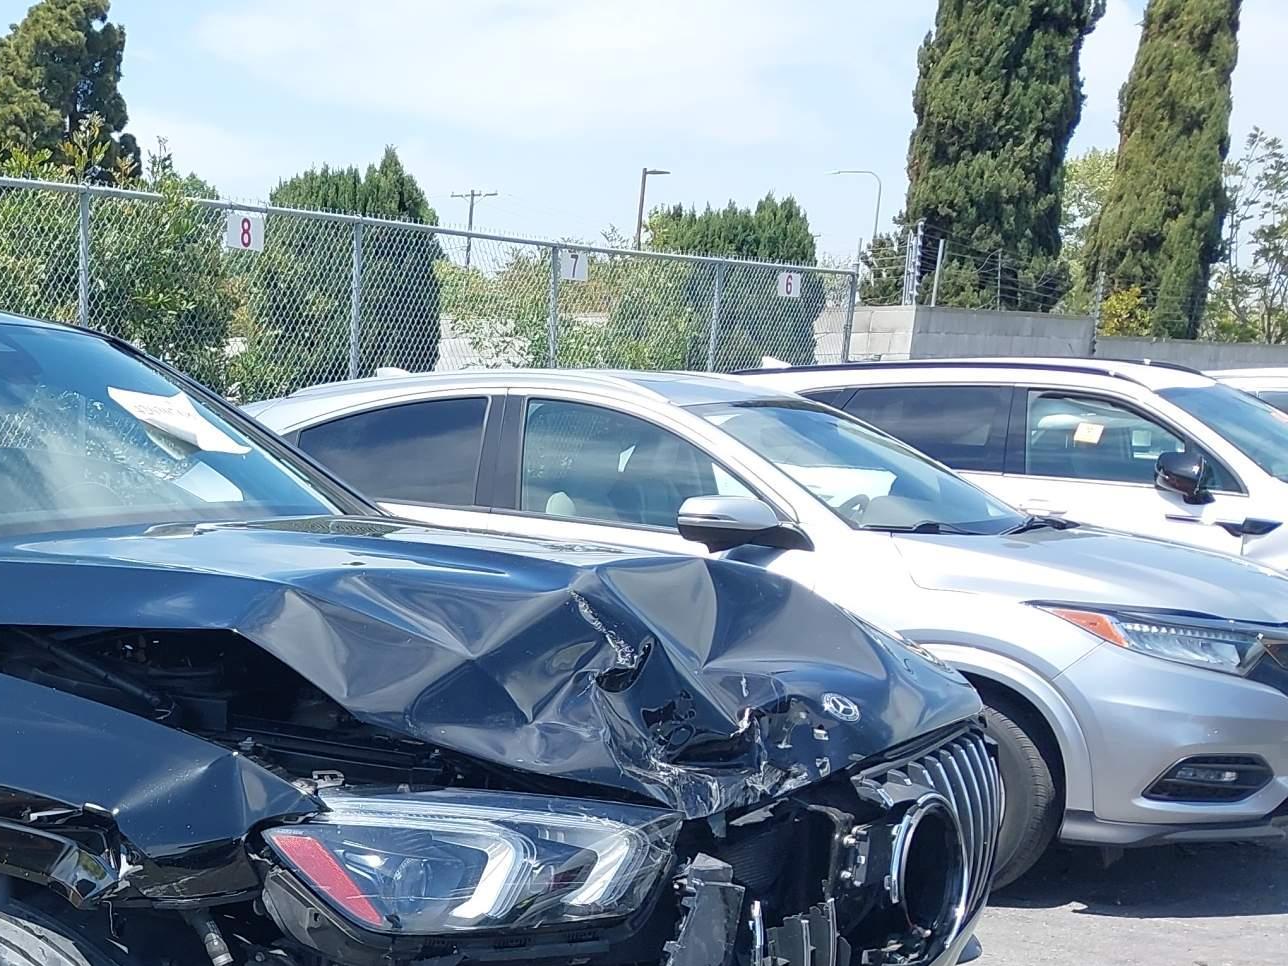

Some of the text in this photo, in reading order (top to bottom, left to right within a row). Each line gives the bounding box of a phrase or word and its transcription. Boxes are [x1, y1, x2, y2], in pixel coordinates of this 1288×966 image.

[241, 217, 251, 248] 8
[570, 254, 579, 278] 7
[785, 274, 793, 295] 6
